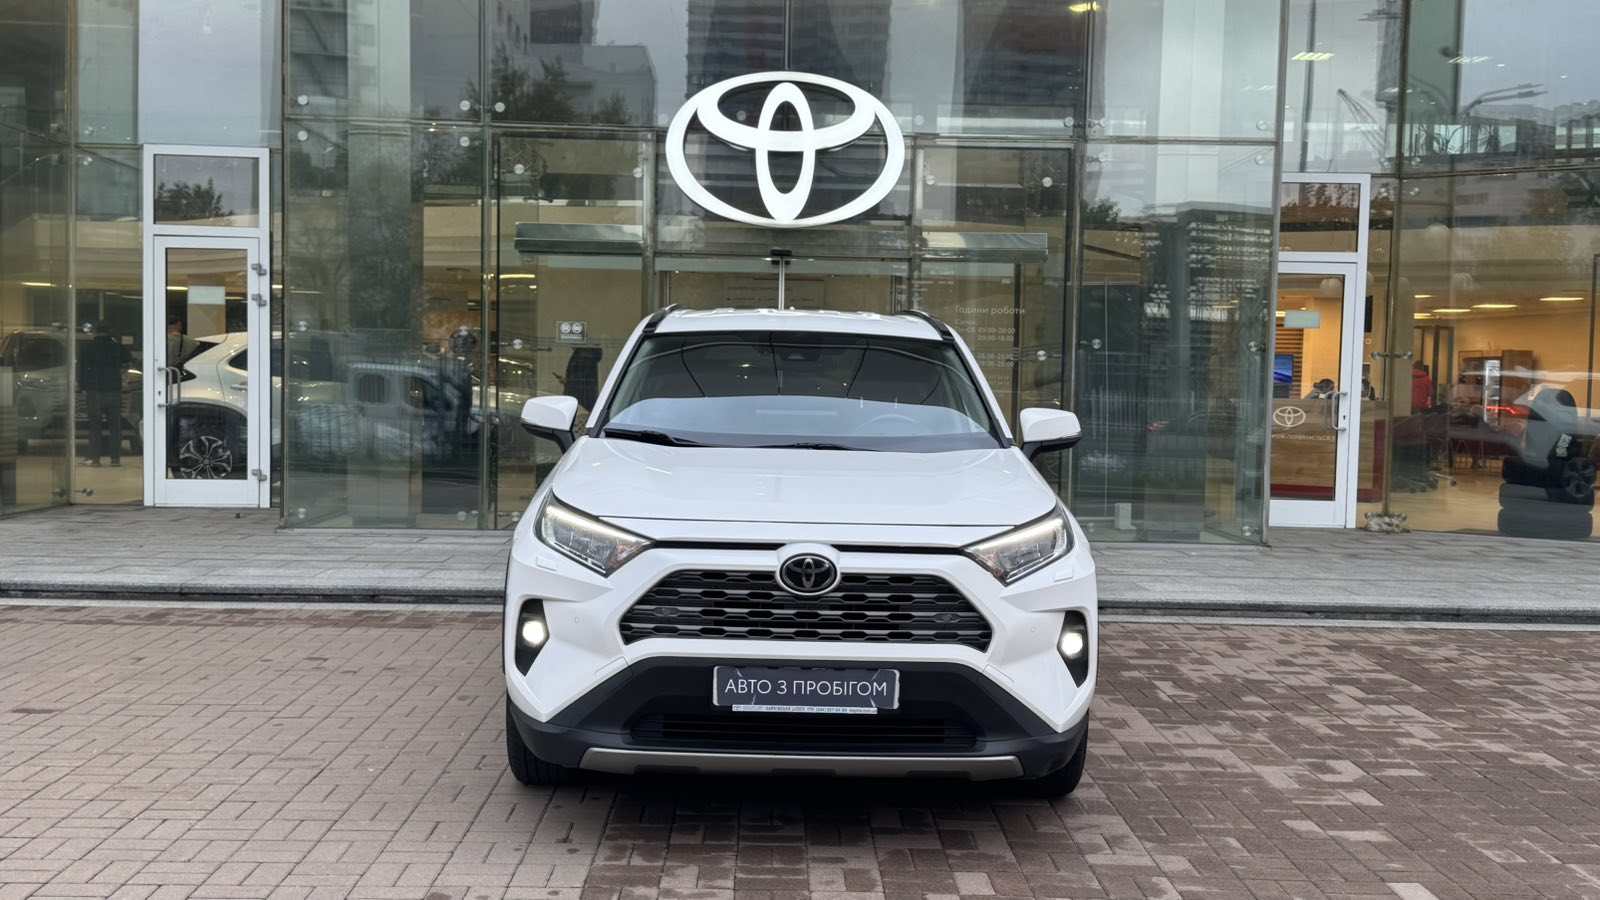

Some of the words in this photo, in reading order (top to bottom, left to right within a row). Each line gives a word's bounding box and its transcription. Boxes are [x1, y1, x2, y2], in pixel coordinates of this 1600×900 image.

[955, 305, 988, 314] Години
[990, 305, 1025, 316] роботи
[724, 679, 772, 694] АВТО
[777, 680, 787, 694] З
[793, 681, 887, 696] ПРОБІГОМ
